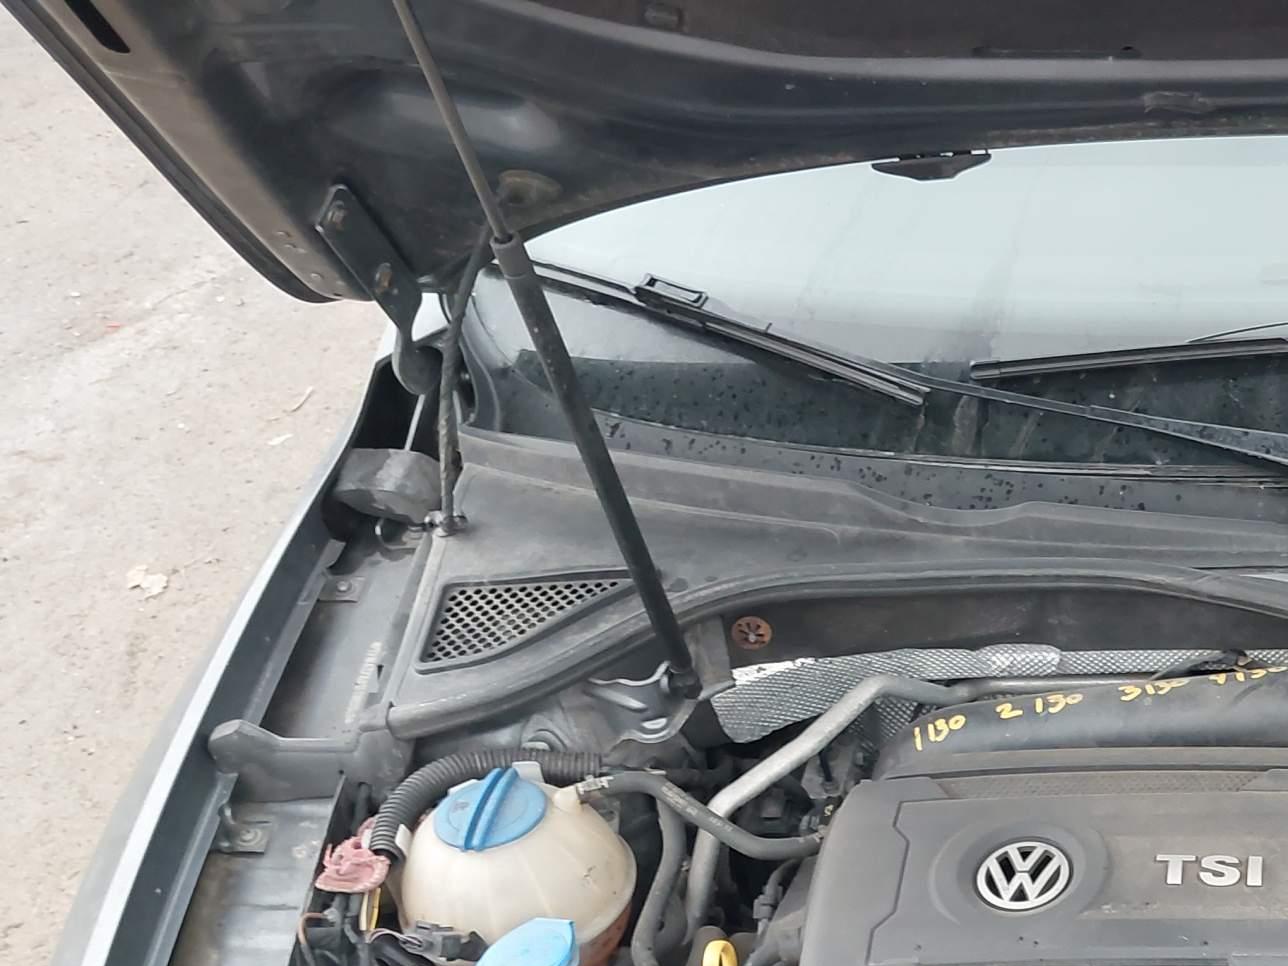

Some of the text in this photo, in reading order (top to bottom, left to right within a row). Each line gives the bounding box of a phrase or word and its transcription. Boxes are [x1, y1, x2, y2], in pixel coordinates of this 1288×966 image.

[995, 702, 1024, 720] 2
[1035, 693, 1084, 714] 130
[1155, 854, 1264, 887] TSI
